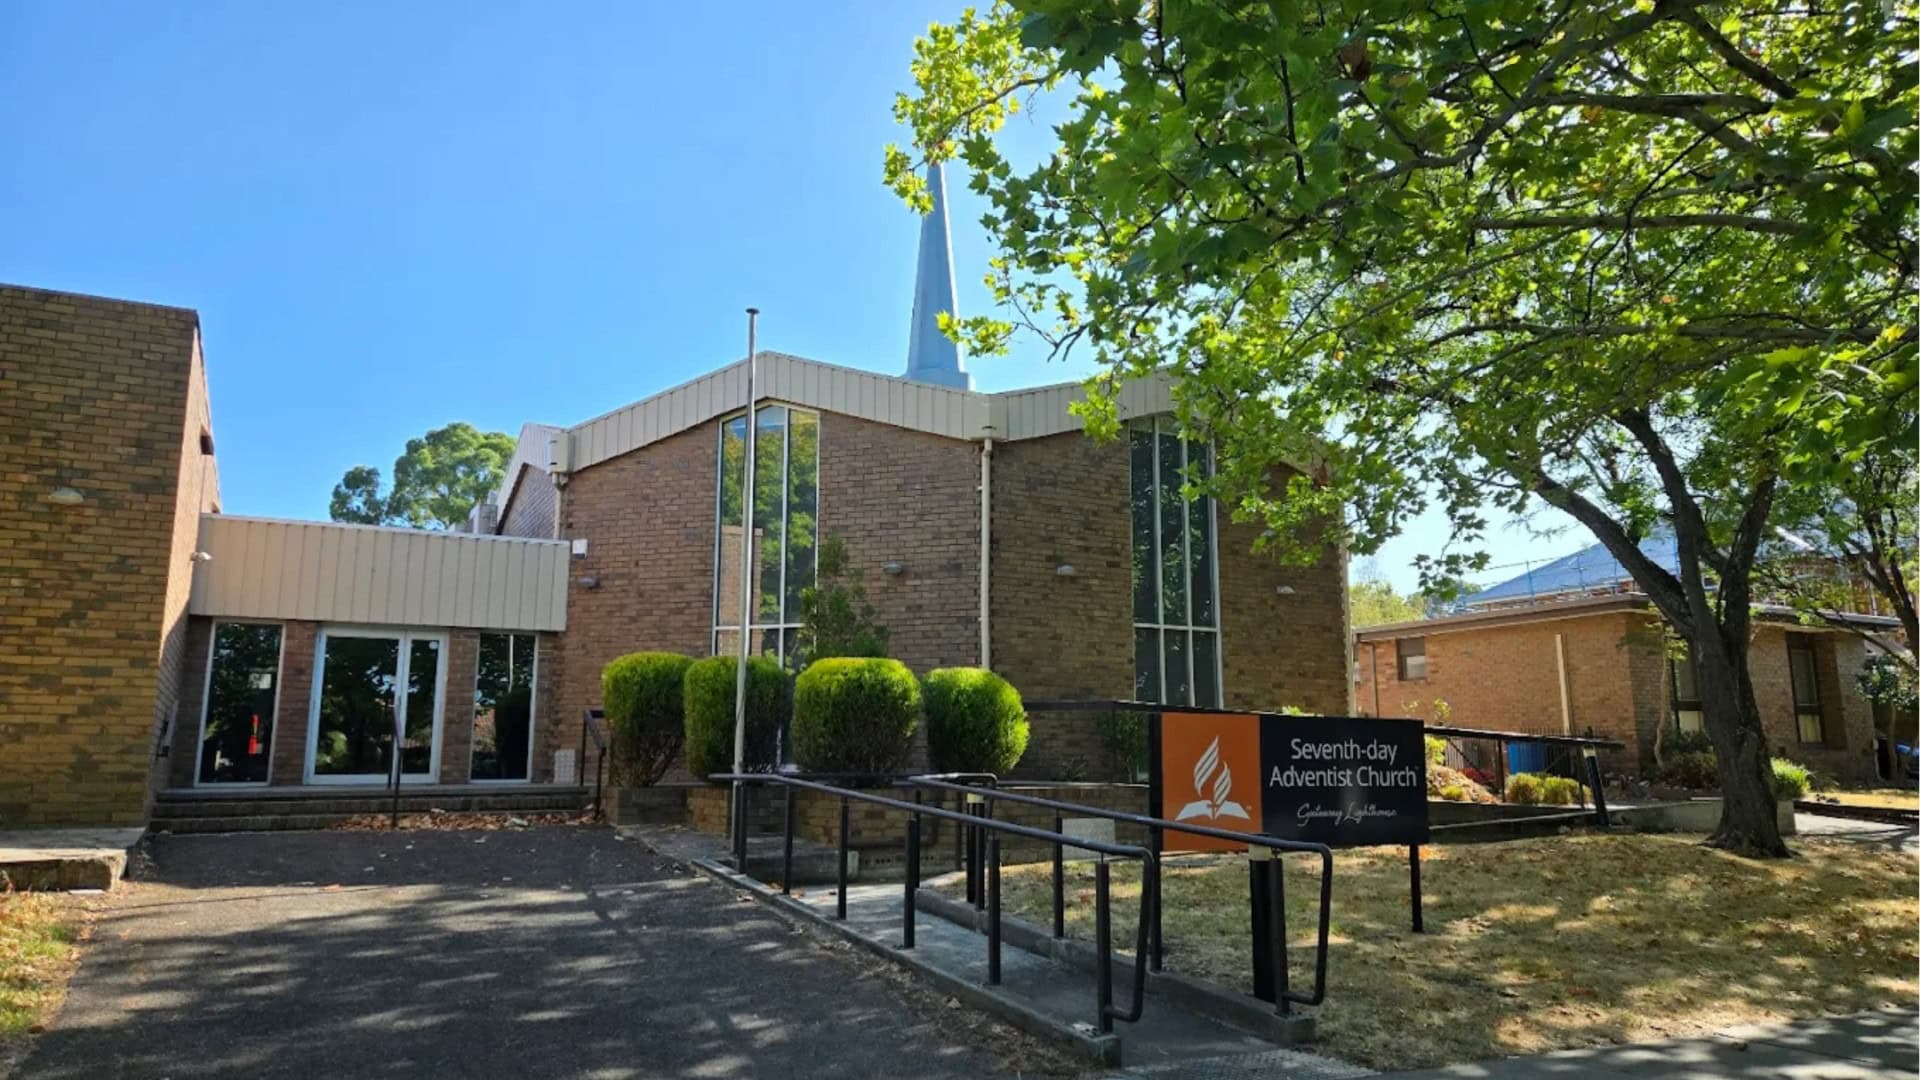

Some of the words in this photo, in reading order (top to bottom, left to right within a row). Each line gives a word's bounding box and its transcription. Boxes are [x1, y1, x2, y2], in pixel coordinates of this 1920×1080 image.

[1290, 738, 1398, 765] Seventh-day
[1269, 765, 1352, 788] Adventist
[1356, 765, 1417, 788] Church
